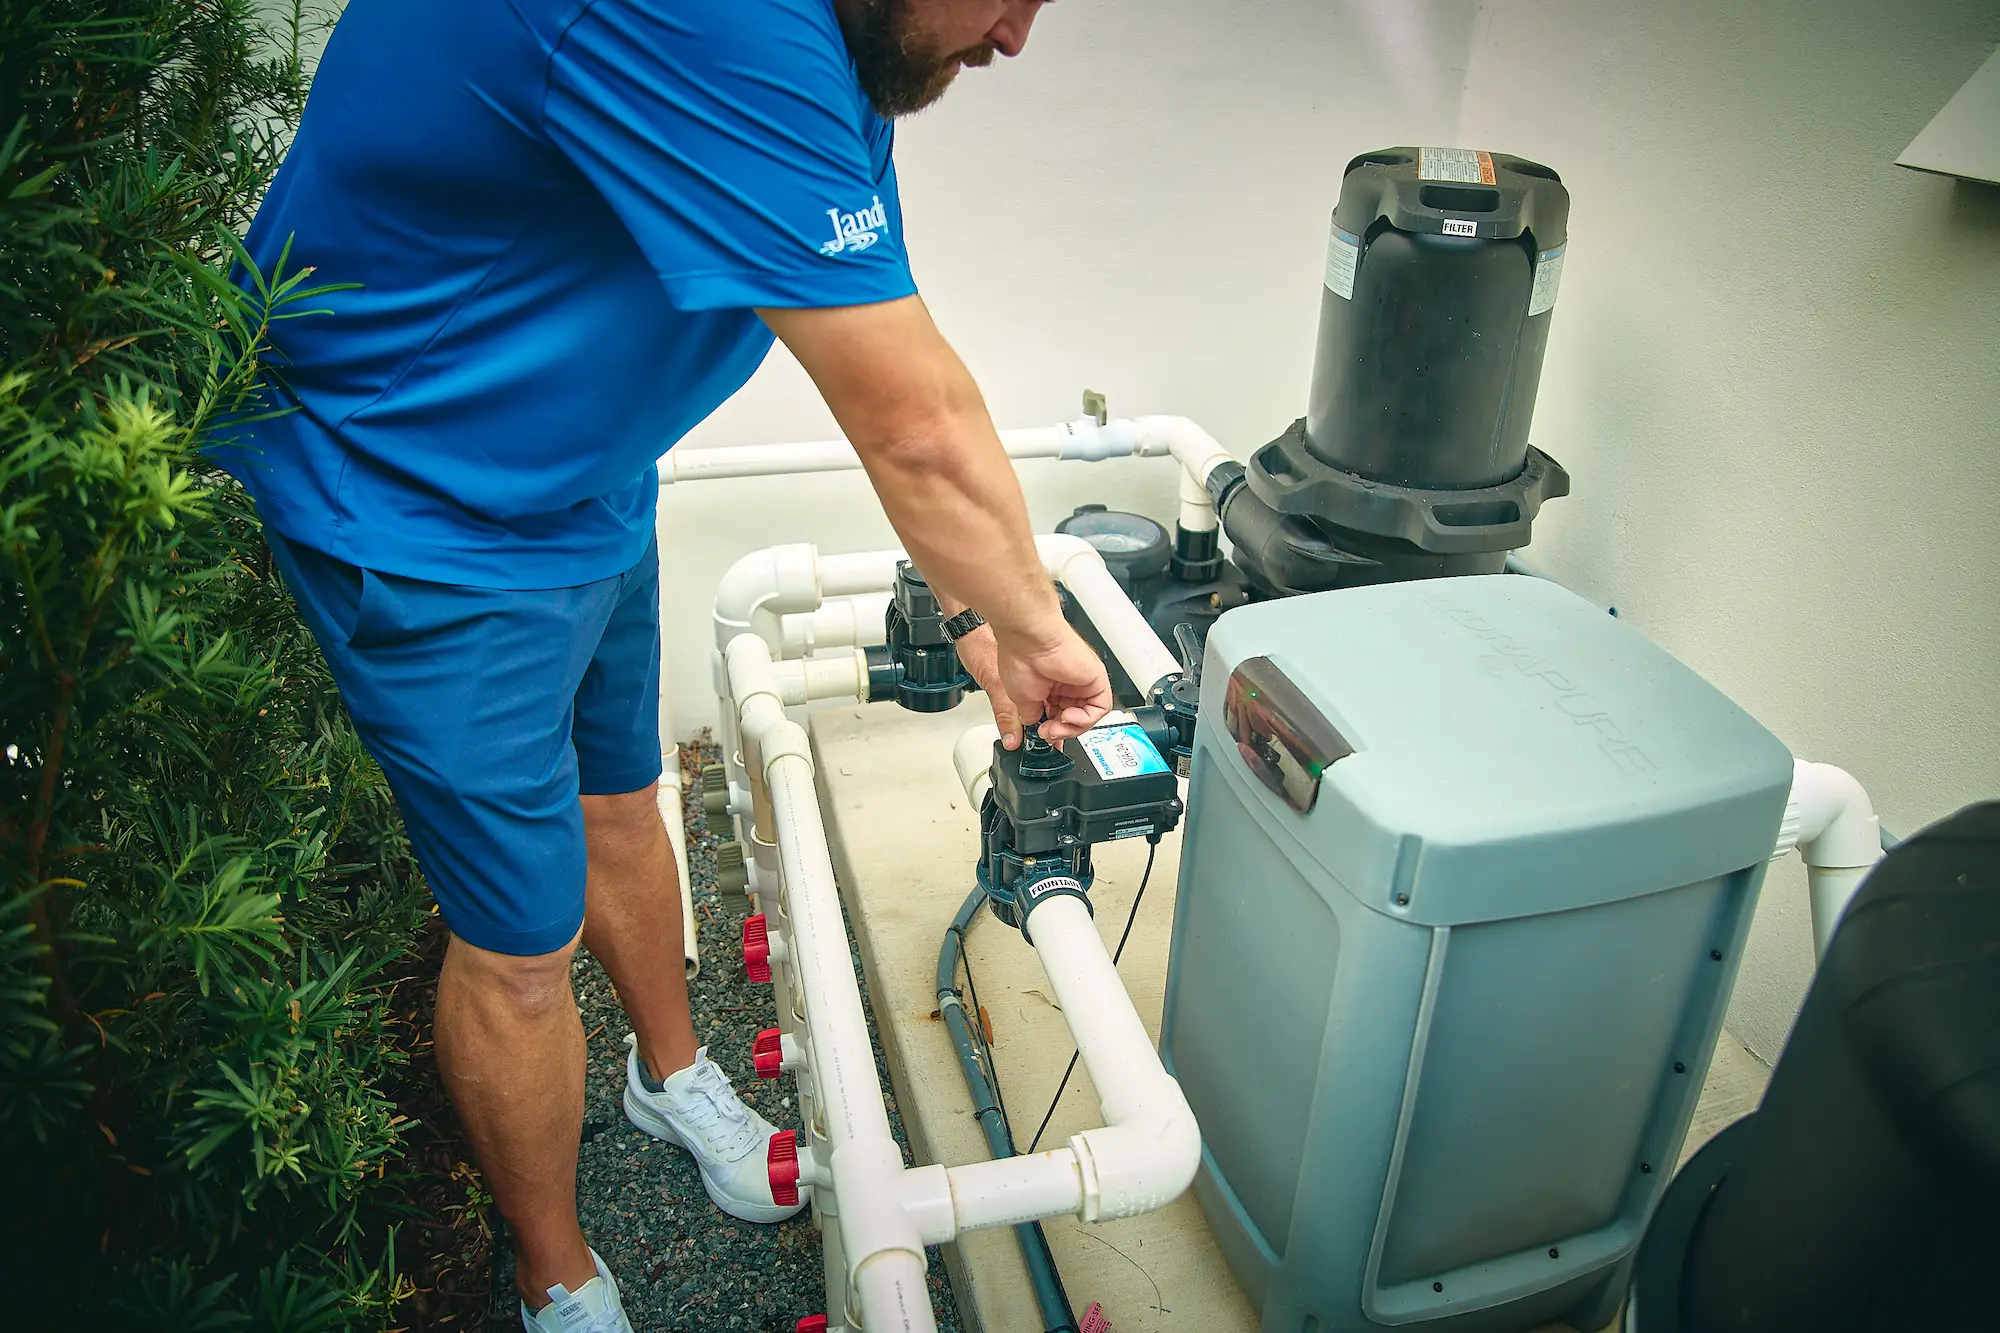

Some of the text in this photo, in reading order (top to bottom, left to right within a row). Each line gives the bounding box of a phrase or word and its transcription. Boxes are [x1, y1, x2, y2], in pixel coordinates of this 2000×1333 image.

[1444, 222, 1474, 235] FILTER
[1114, 743, 1138, 768] GVA-24
[1032, 879, 1079, 895] FOUNTAIN
[560, 1301, 579, 1317] VANS
